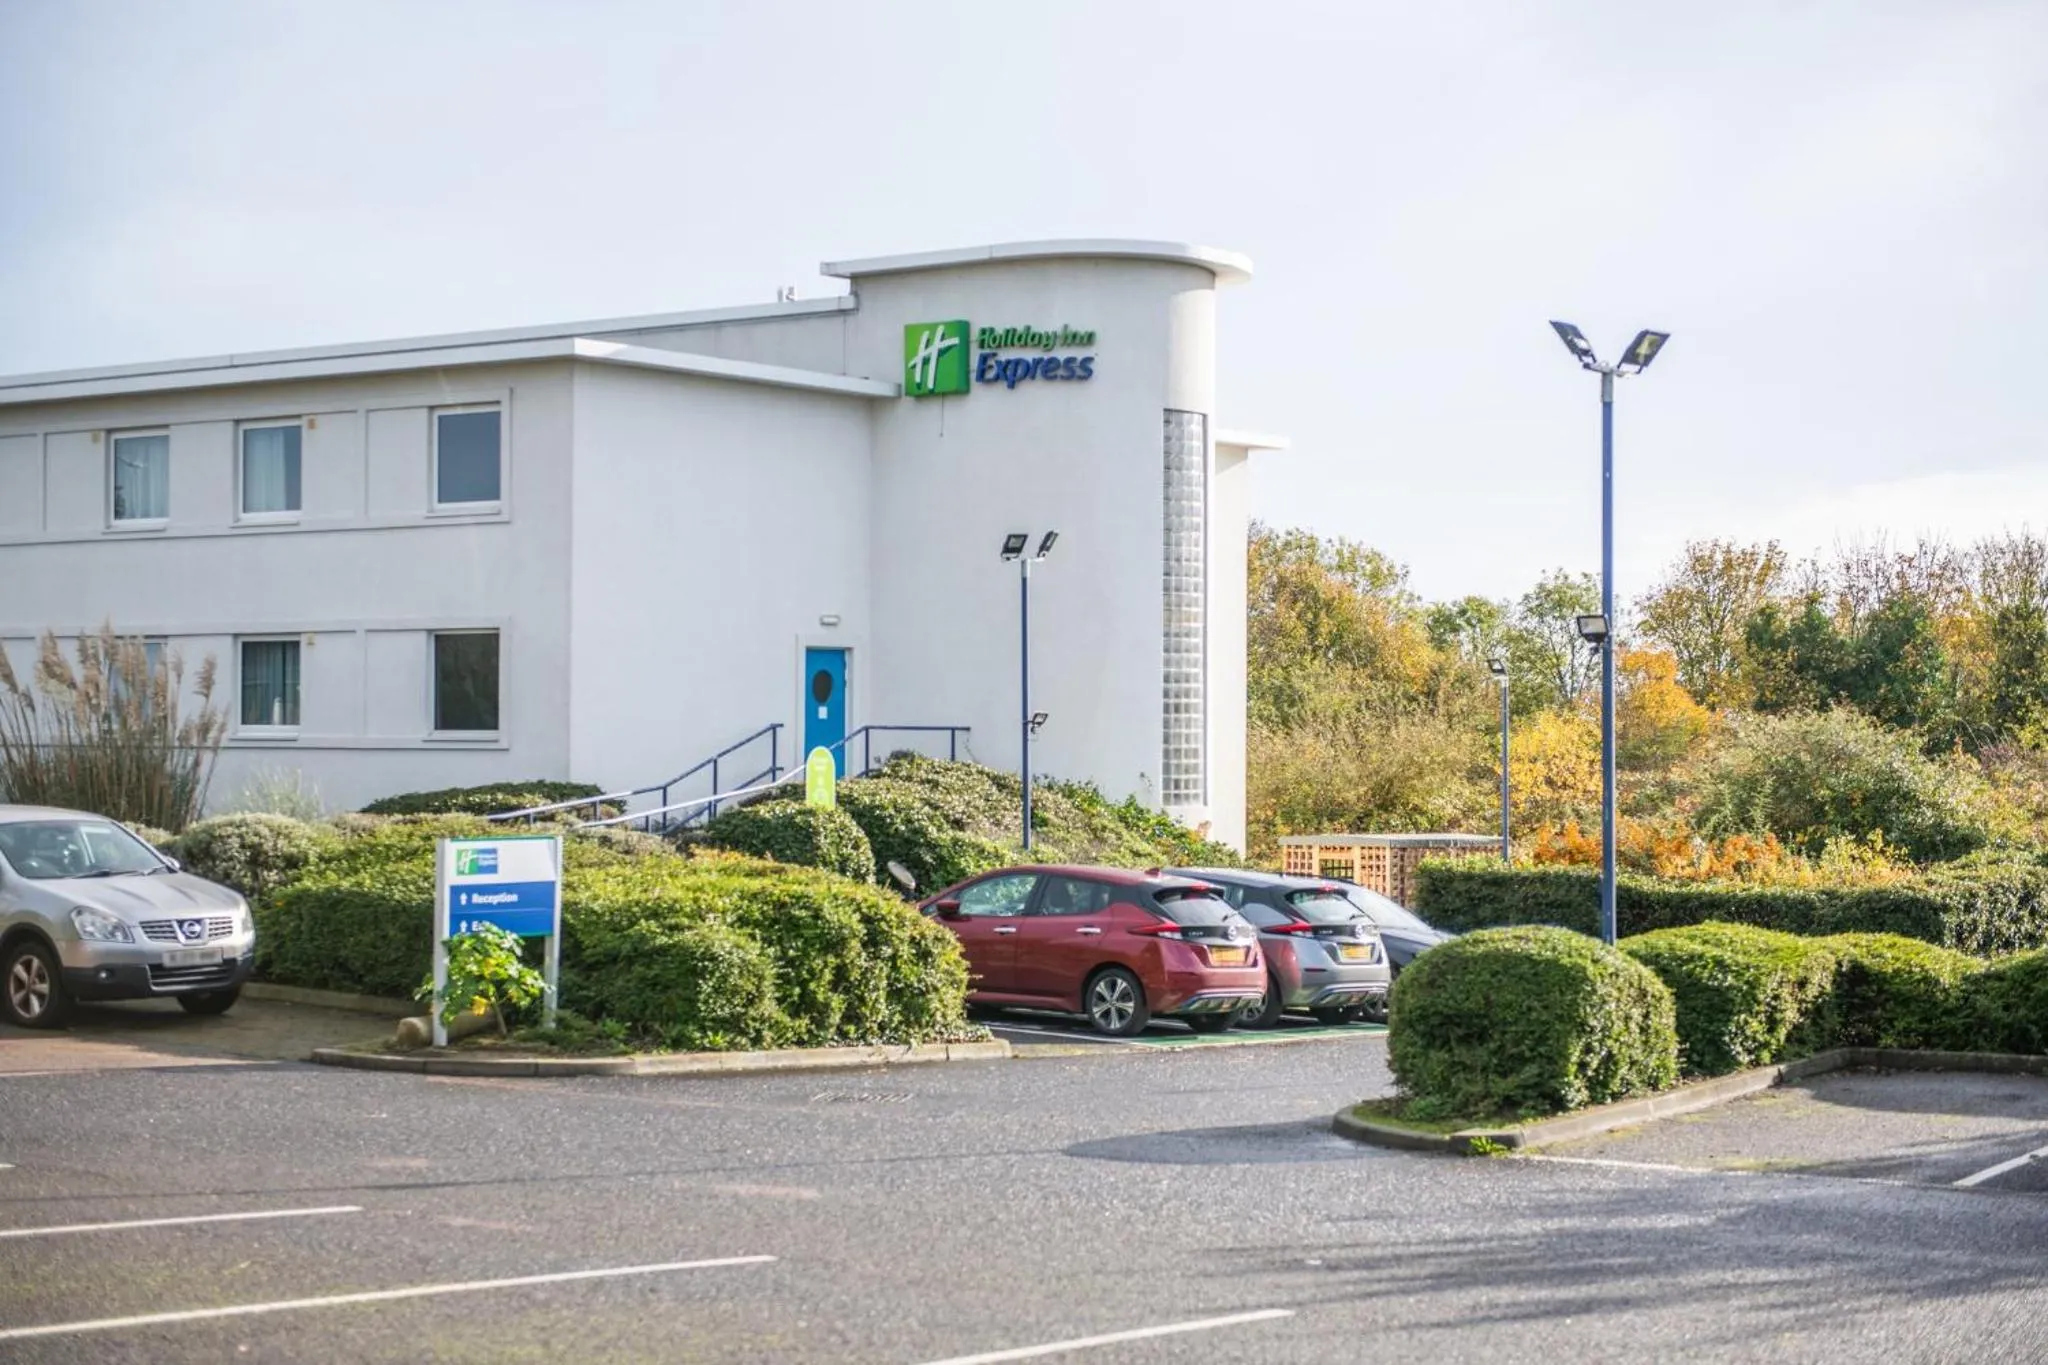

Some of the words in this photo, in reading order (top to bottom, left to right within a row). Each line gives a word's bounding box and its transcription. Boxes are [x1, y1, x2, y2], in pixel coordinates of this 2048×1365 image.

[977, 325, 1057, 351] Holiday
[1060, 324, 1096, 347] Inn
[975, 352, 1095, 389] Express
[471, 892, 518, 905] Reception
